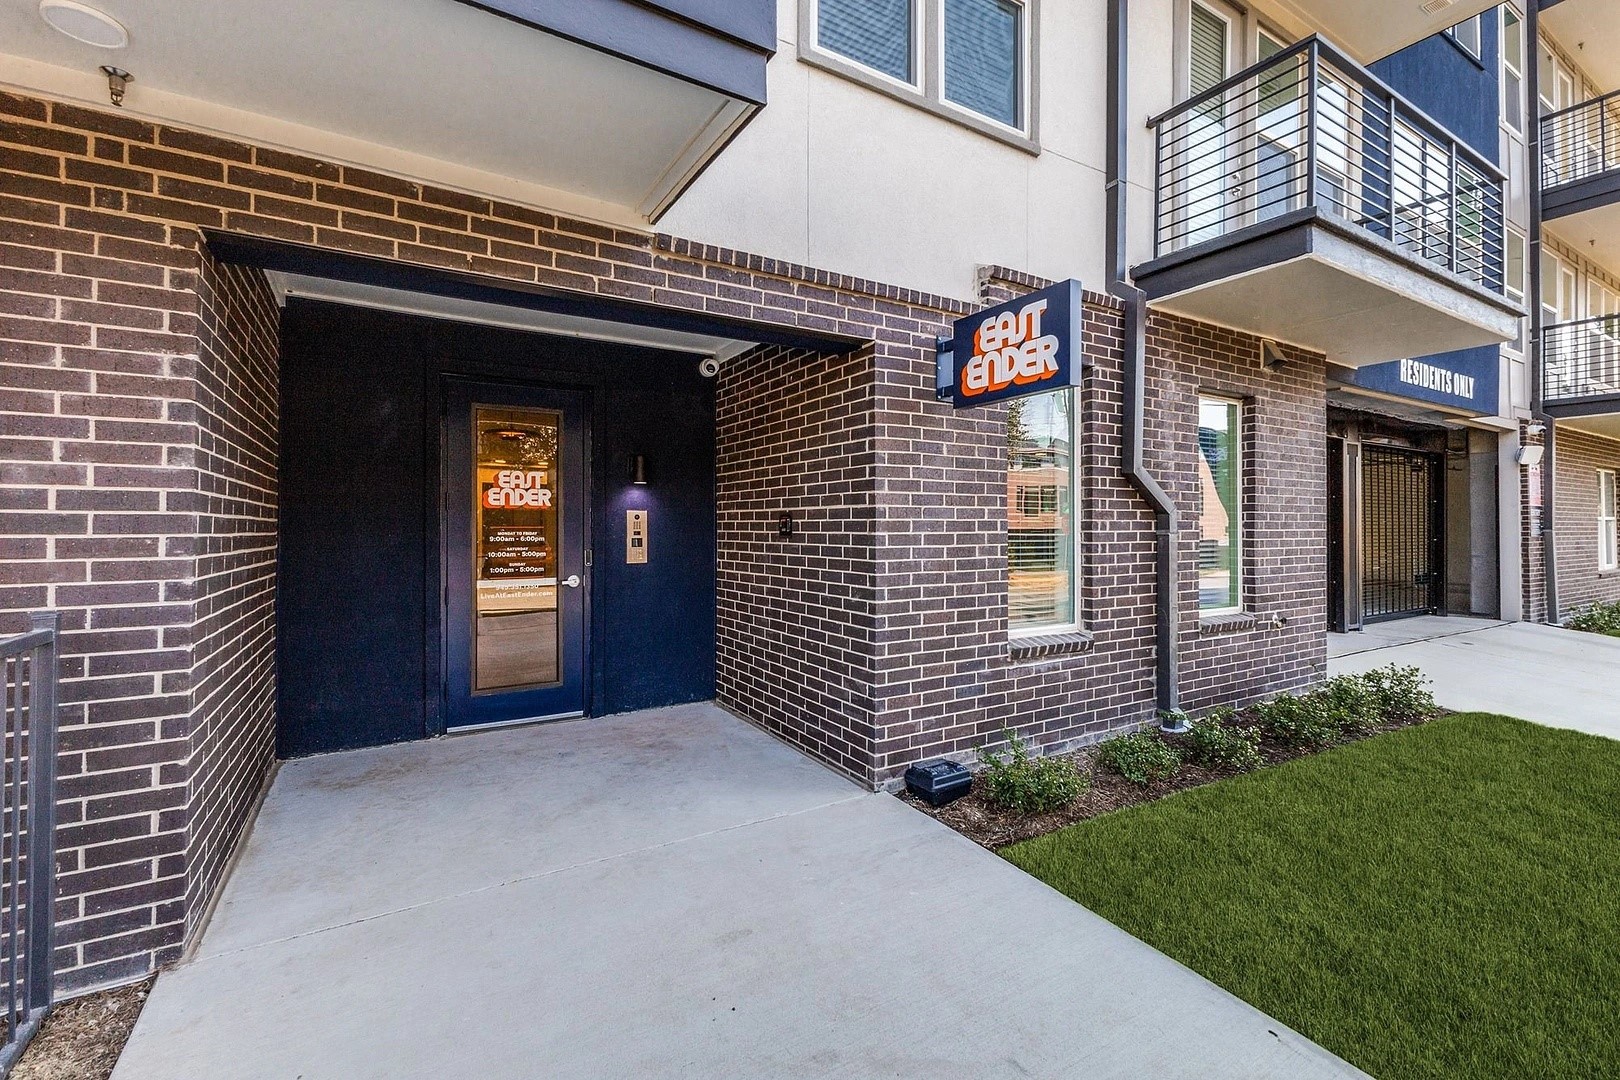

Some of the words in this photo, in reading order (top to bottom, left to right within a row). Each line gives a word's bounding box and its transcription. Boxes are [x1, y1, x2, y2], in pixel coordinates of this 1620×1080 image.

[979, 298, 1048, 353] EAST
[965, 334, 1060, 390] ENDER
[1400, 358, 1452, 394] RESIDENTS
[1453, 372, 1475, 400] ONLY
[497, 470, 545, 489] EAST
[487, 487, 552, 507] ENDER
[520, 535, 545, 543] 6:00pm
[480, 591, 553, 599] LiveAtEastEnder.com
